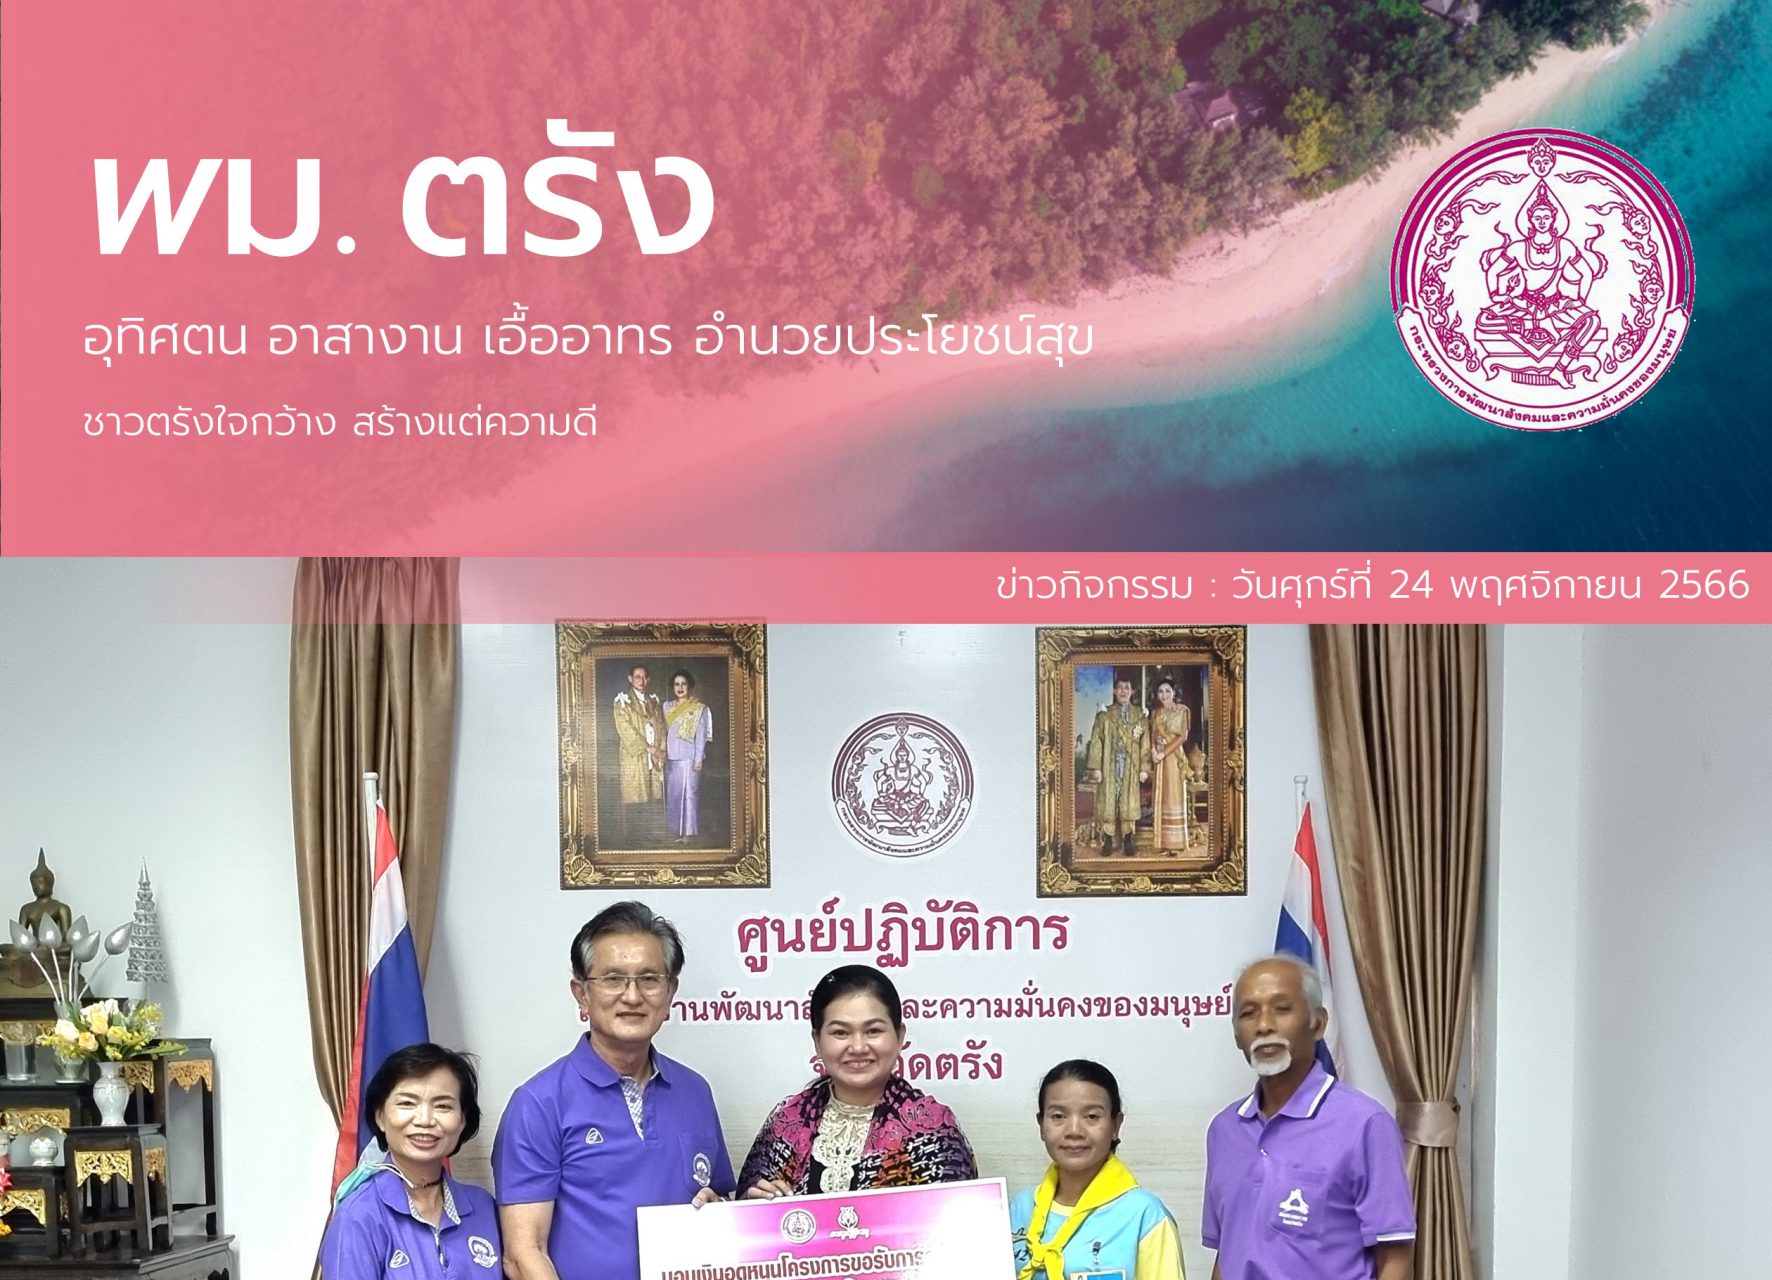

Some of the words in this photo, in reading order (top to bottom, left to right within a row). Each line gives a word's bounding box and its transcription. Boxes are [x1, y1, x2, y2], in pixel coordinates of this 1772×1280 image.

[737, 896, 1071, 973] ศูนย์ปฏิบัติการ
